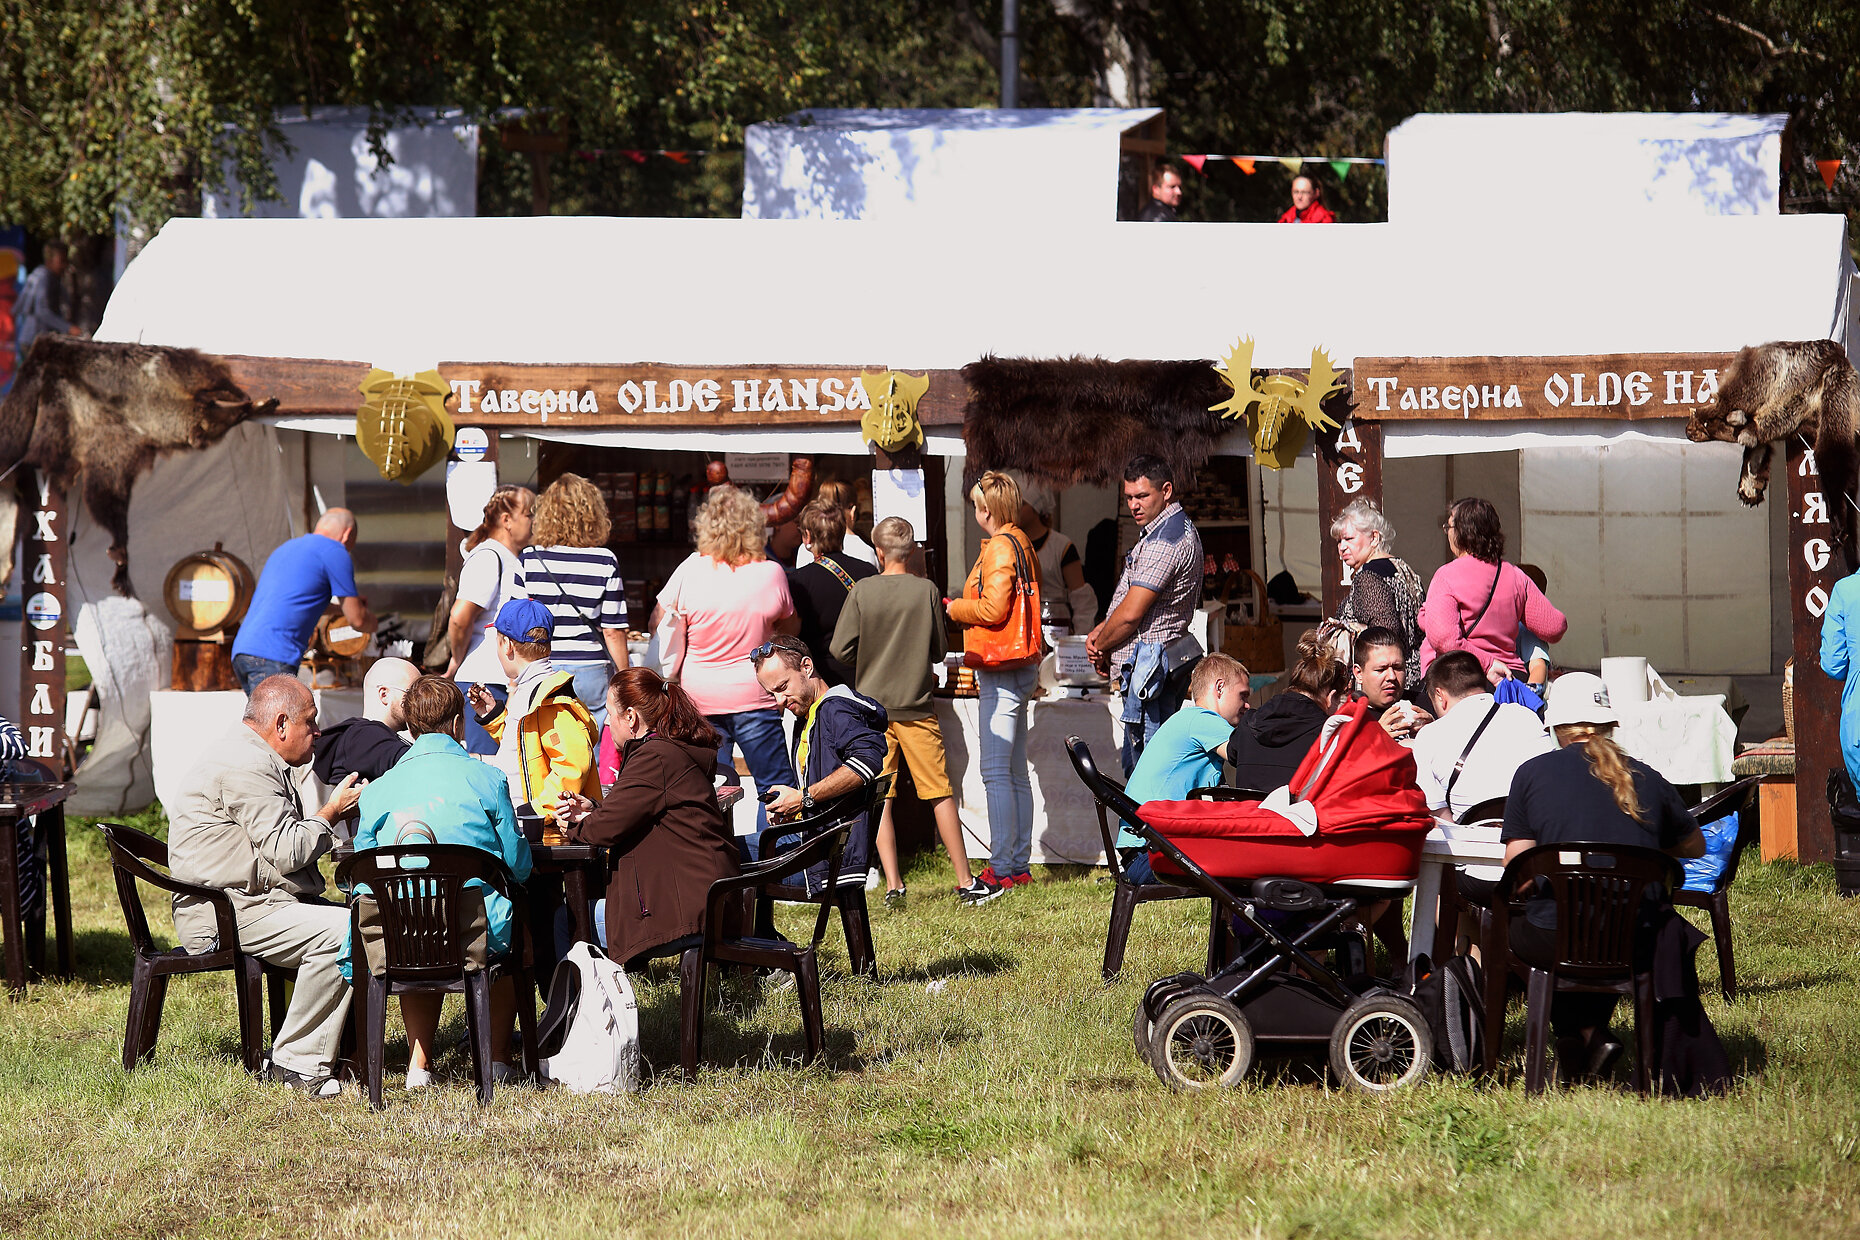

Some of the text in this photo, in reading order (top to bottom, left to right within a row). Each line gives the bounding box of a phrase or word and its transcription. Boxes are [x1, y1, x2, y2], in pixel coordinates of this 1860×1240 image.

[450, 377, 871, 422] Таверна OLDE HANSA
[1367, 376, 1523, 419] Таверна
[1544, 371, 1653, 407] OLDE
